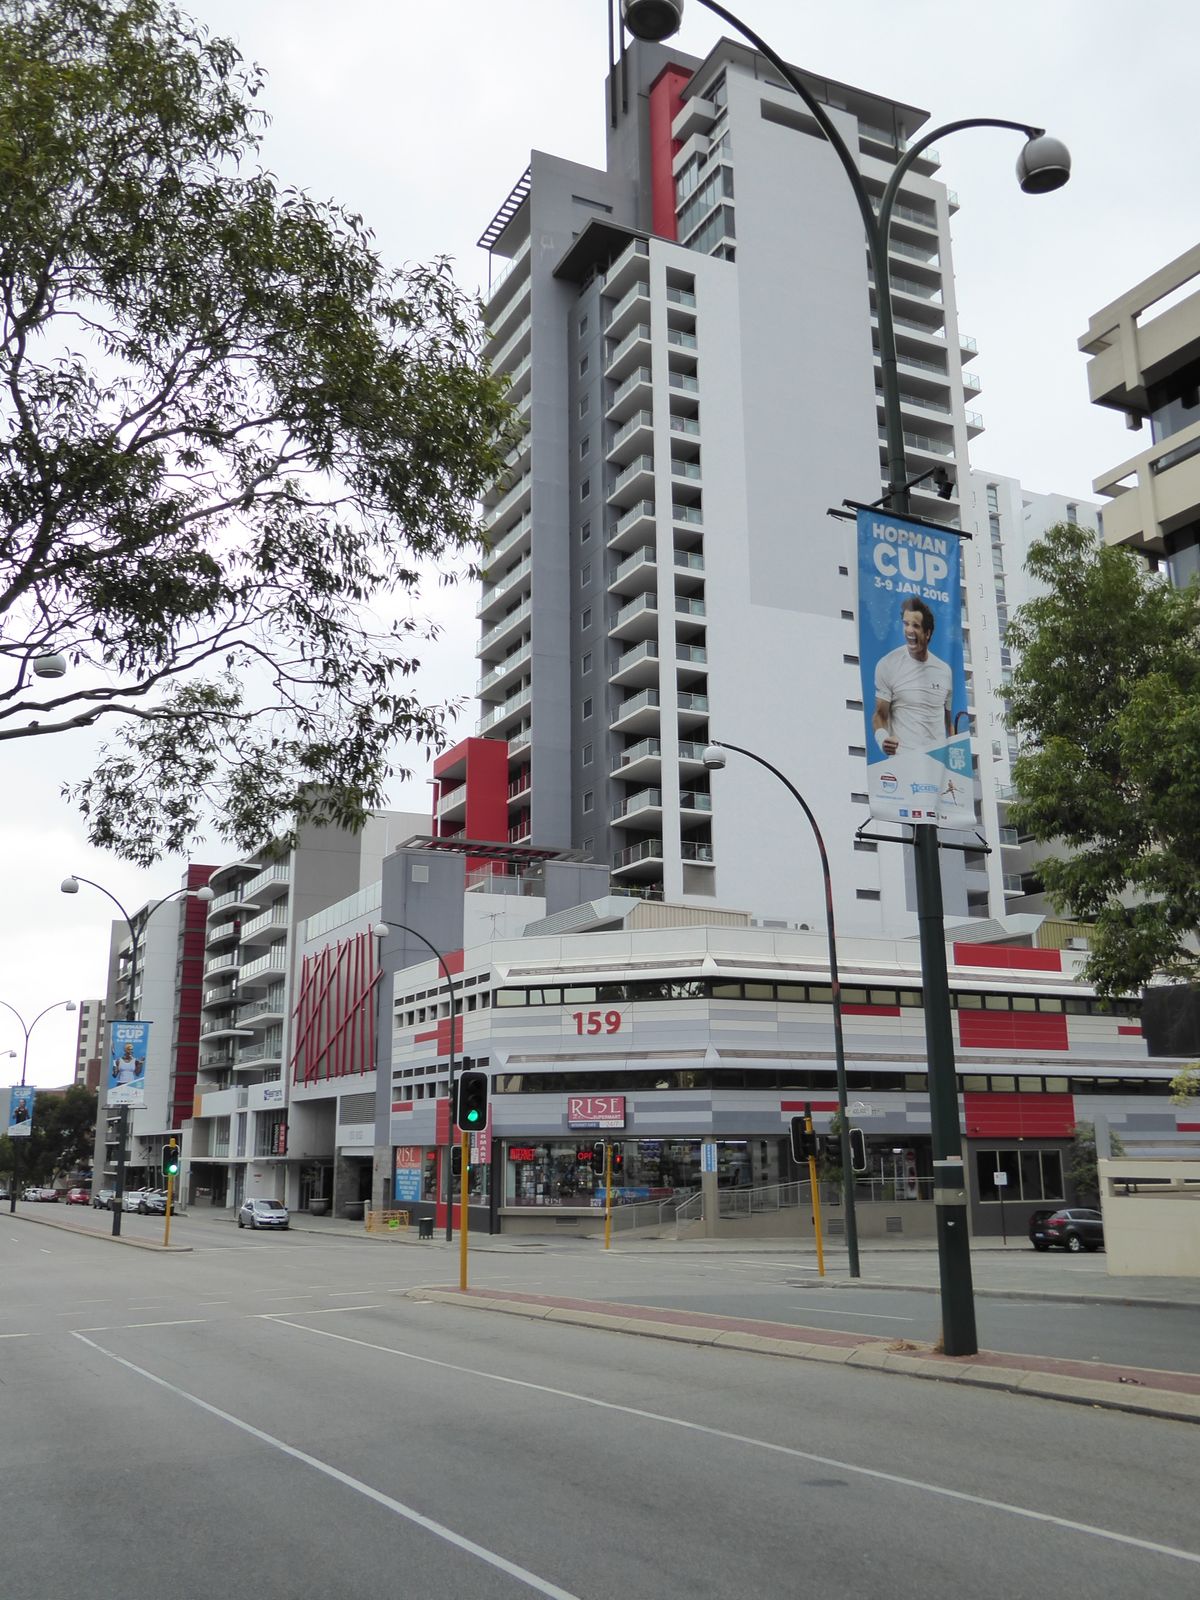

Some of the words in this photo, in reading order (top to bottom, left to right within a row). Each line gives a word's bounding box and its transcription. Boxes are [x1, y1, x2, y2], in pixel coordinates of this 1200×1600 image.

[872, 523, 946, 555] HOPMAN
[873, 542, 948, 586] CUP
[874, 576, 893, 590] 3-9
[896, 582, 920, 595] JAN
[923, 587, 949, 602] 2016
[117, 1029, 144, 1039] CUP
[573, 1010, 621, 1035] 159
[571, 1098, 621, 1119] RISE
[396, 1147, 415, 1167] RISE
